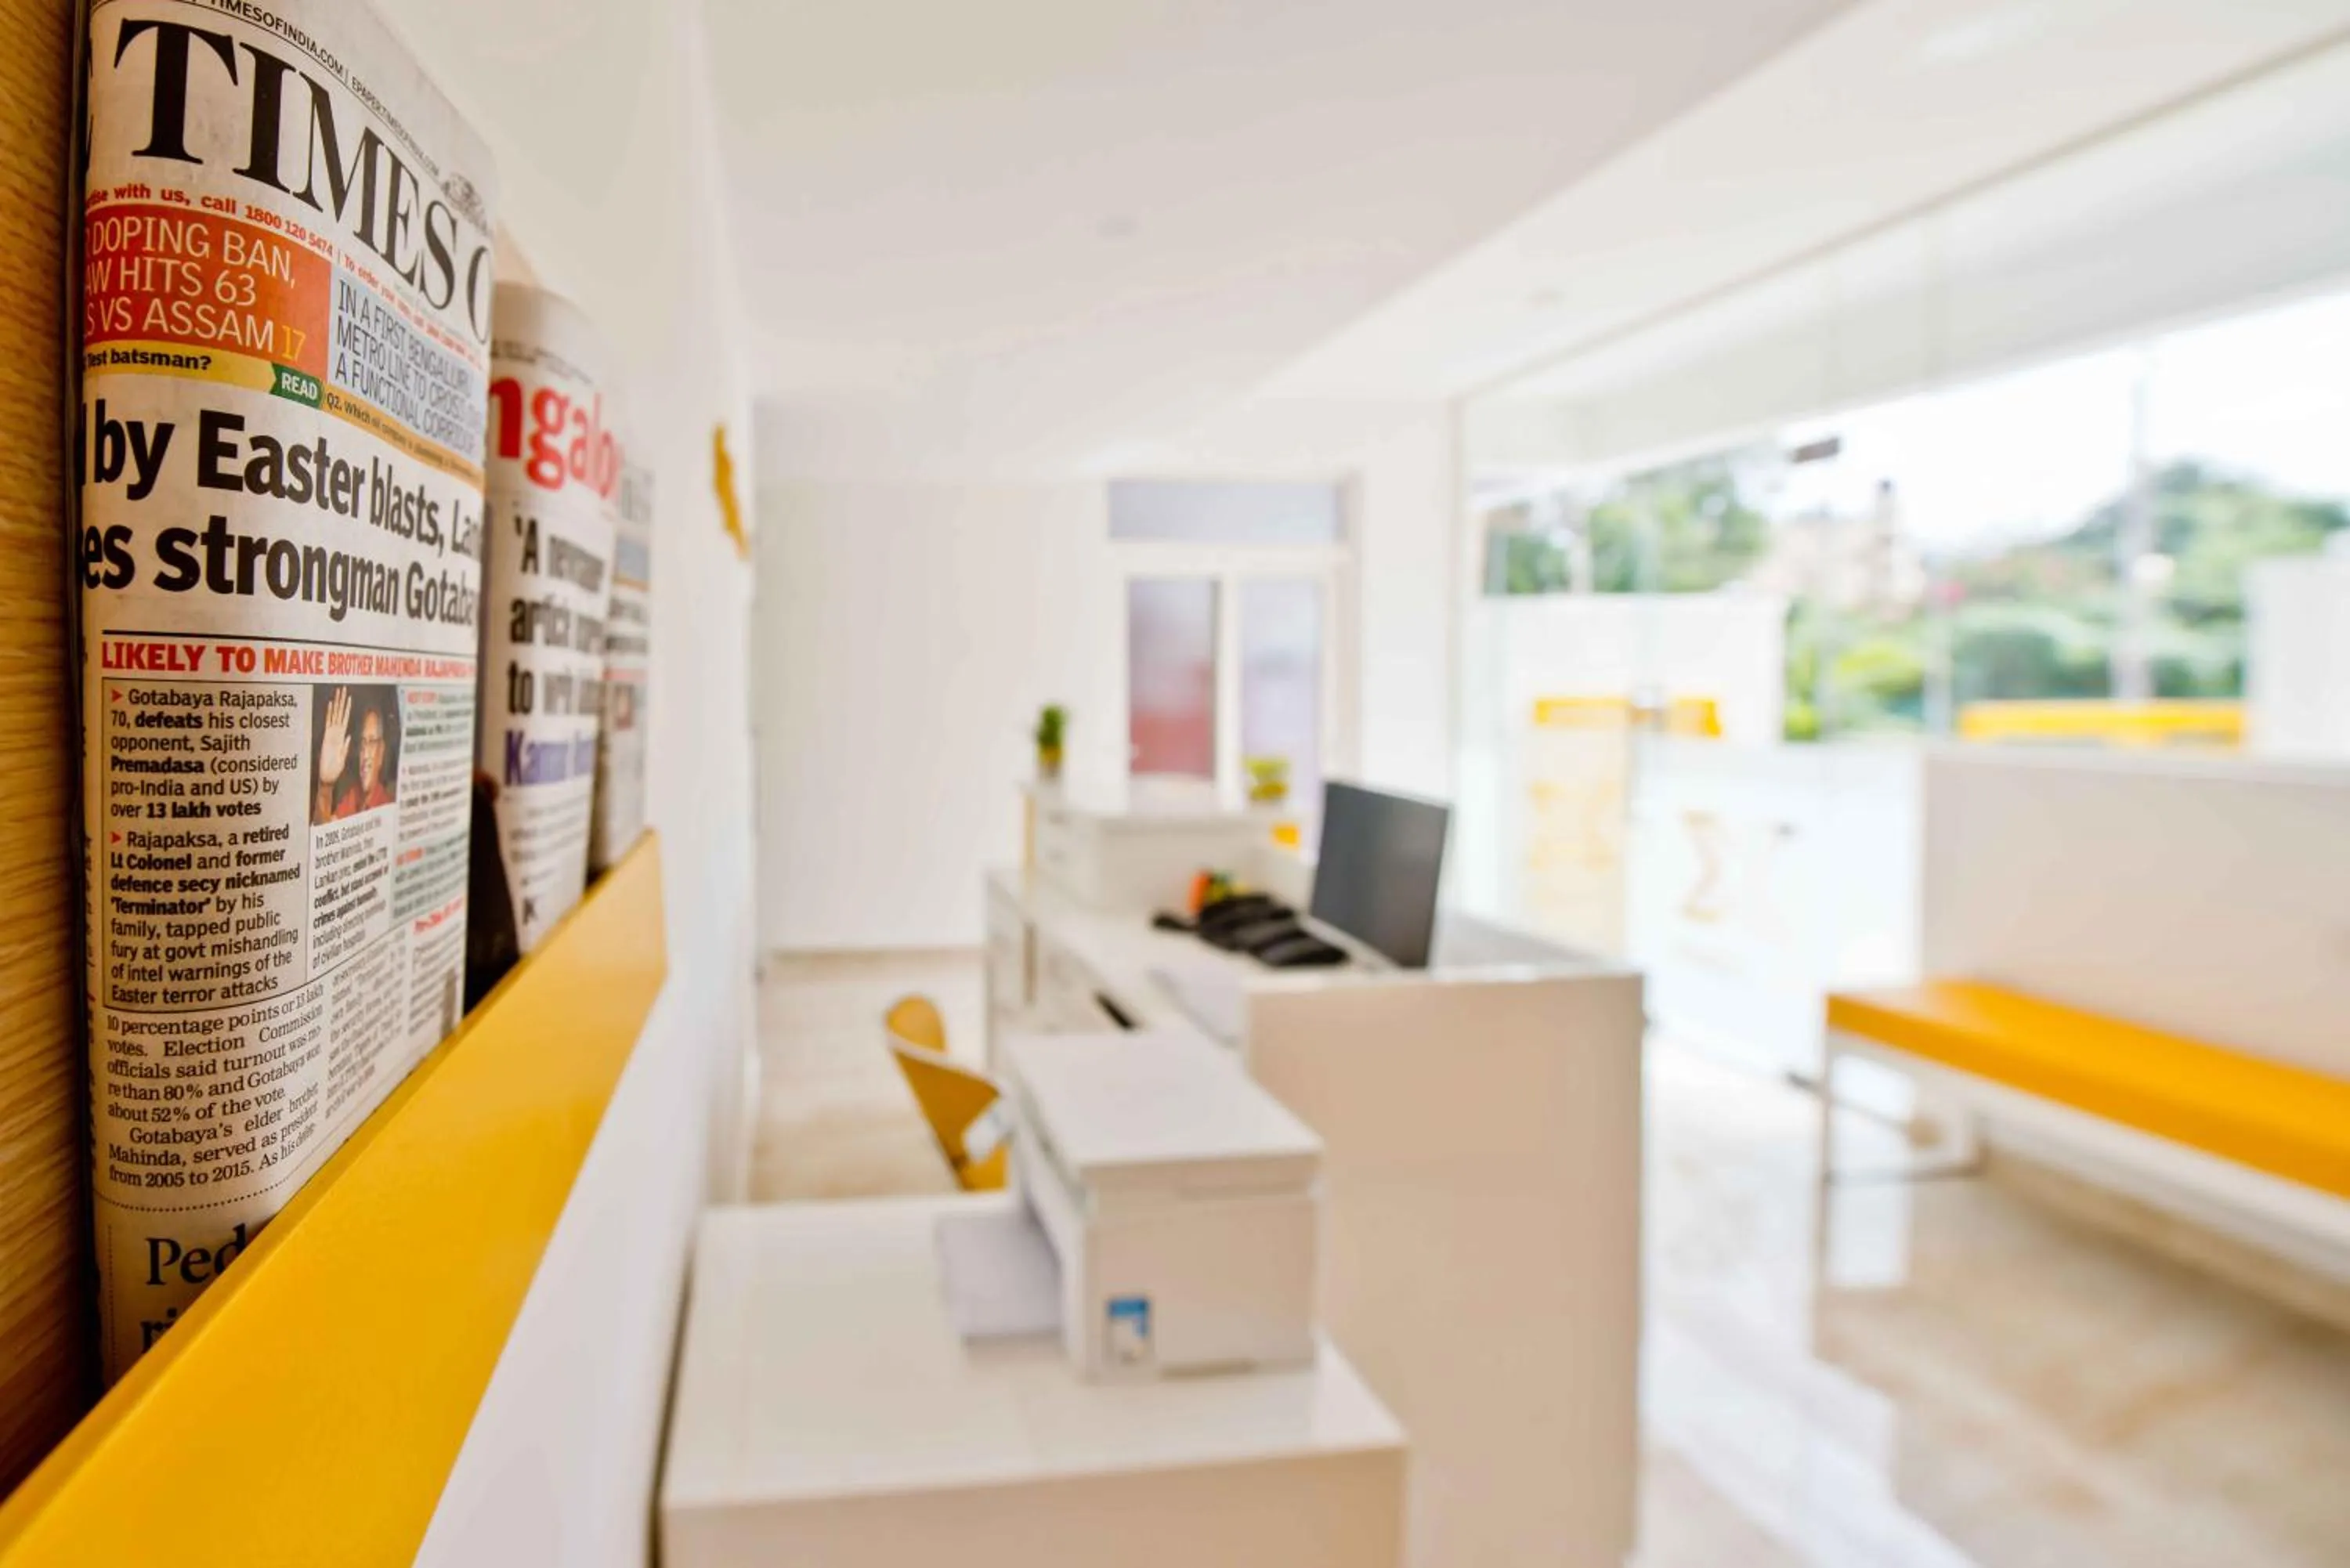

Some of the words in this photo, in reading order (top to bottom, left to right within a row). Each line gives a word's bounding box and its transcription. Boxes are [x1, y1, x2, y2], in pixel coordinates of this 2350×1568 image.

[114, 19, 457, 310] TIMES
[114, 182, 151, 200] with
[161, 188, 190, 206] us,
[201, 195, 236, 214] call
[244, 205, 281, 229] 1800
[285, 220, 306, 241] 120
[92, 216, 210, 259] DOPING
[223, 230, 295, 289] BAN,
[119, 256, 203, 298] HITS
[215, 270, 257, 307] 63
[338, 279, 357, 320] IN
[360, 297, 371, 329] A
[99, 296, 133, 333] VS
[143, 297, 274, 353] ASSAM
[282, 325, 307, 361] 17
[338, 315, 385, 370] METRO
[111, 349, 212, 370] batsman?
[335, 352, 347, 384] A
[281, 372, 318, 401] READ
[344, 402, 371, 424] Which
[93, 398, 175, 501] by
[197, 410, 366, 519] Easter
[370, 455, 444, 558] blasts,
[153, 515, 400, 623] strongman
[101, 641, 206, 671] LIKELY
[215, 646, 257, 674] TO
[264, 648, 324, 675] MAKE
[128, 688, 214, 709] Gotabaya
[219, 690, 298, 710] Rajapaksa,
[110, 710, 131, 729] 70,
[135, 710, 204, 728] defeats
[208, 712, 234, 728] his
[239, 713, 290, 728] closest
[110, 735, 195, 753] opponent,
[200, 734, 251, 754] Sajith
[110, 756, 205, 774] Premadasa
[210, 753, 298, 775] (considered
[110, 779, 185, 797] pro-India
[190, 779, 224, 795] and
[230, 777, 258, 796] US)
[262, 776, 280, 794] by
[110, 804, 141, 818] over
[146, 802, 166, 818] 13
[172, 801, 211, 818] lakh
[216, 801, 262, 818] votes
[127, 830, 223, 851] Rajapaksa,
[228, 833, 238, 845] a
[243, 823, 290, 845] retired
[110, 852, 123, 869] Lt
[126, 853, 192, 870] Colonel
[197, 852, 231, 869] and
[235, 848, 286, 866] former
[110, 874, 173, 894] defence
[177, 876, 222, 894] secy
[225, 863, 301, 891] nicknamed
[215, 896, 237, 915] by
[241, 893, 265, 910] his
[111, 918, 161, 939] family,
[166, 918, 230, 939] tapped
[235, 910, 281, 935] public
[111, 943, 138, 963] fury
[143, 944, 161, 960] at
[164, 944, 207, 963] govt
[211, 927, 299, 958] mishandling
[111, 963, 125, 979] of
[127, 963, 164, 982] intel
[168, 960, 251, 982] warnings
[255, 956, 271, 973] of
[273, 950, 293, 968] the
[111, 985, 158, 1005] Easter
[162, 987, 216, 1004] terror
[220, 976, 279, 999] attacks
[107, 1014, 120, 1031] 10
[121, 1017, 224, 1036] percentage
[229, 1005, 280, 1031] points
[281, 999, 295, 1015] or
[107, 1039, 149, 1057] votes.
[163, 1035, 246, 1057] Election
[107, 1058, 171, 1079] officials
[175, 1059, 217, 1079] said
[222, 1044, 286, 1072] turnout
[164, 1086, 204, 1100] 80%
[208, 1076, 245, 1097] and
[247, 1055, 306, 1088] Gotabaya
[107, 1102, 149, 1122] about
[151, 1107, 190, 1123] 52%
[195, 1100, 219, 1119] of
[221, 1097, 252, 1117] the
[129, 1122, 233, 1145] Gotabaya's
[244, 1108, 284, 1132] elder
[108, 1143, 187, 1167] Mahinda,
[193, 1137, 257, 1162] served
[261, 1131, 277, 1148] as
[108, 1165, 143, 1187] from
[145, 1171, 185, 1188] 2005
[189, 1169, 209, 1185] to
[212, 1161, 255, 1183] 2015.
[258, 1151, 279, 1170] As
[280, 1140, 295, 1160] his
[145, 1222, 247, 1286] Ped
